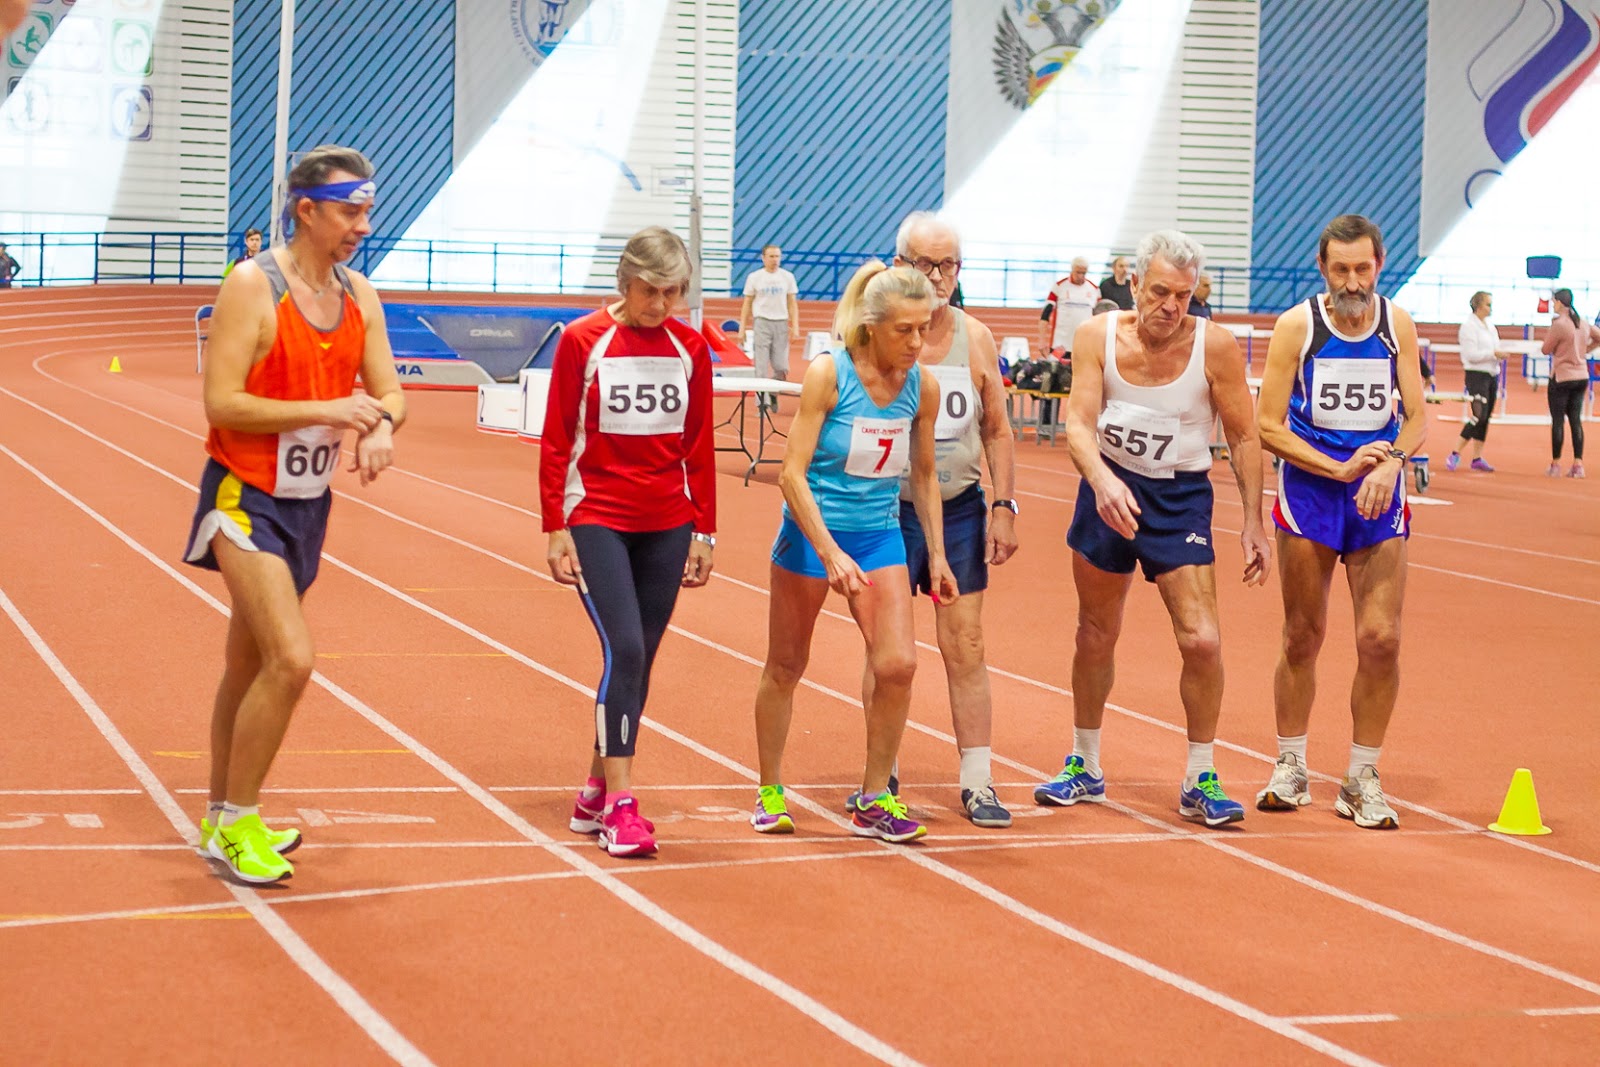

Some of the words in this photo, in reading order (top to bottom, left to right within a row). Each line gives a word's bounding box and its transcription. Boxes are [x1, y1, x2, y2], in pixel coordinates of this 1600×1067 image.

[395, 365, 423, 376] MA
[607, 383, 682, 414] 558
[1318, 383, 1387, 411] 555
[285, 440, 340, 477] 607
[873, 438, 894, 474] 7
[1104, 423, 1174, 461] 557
